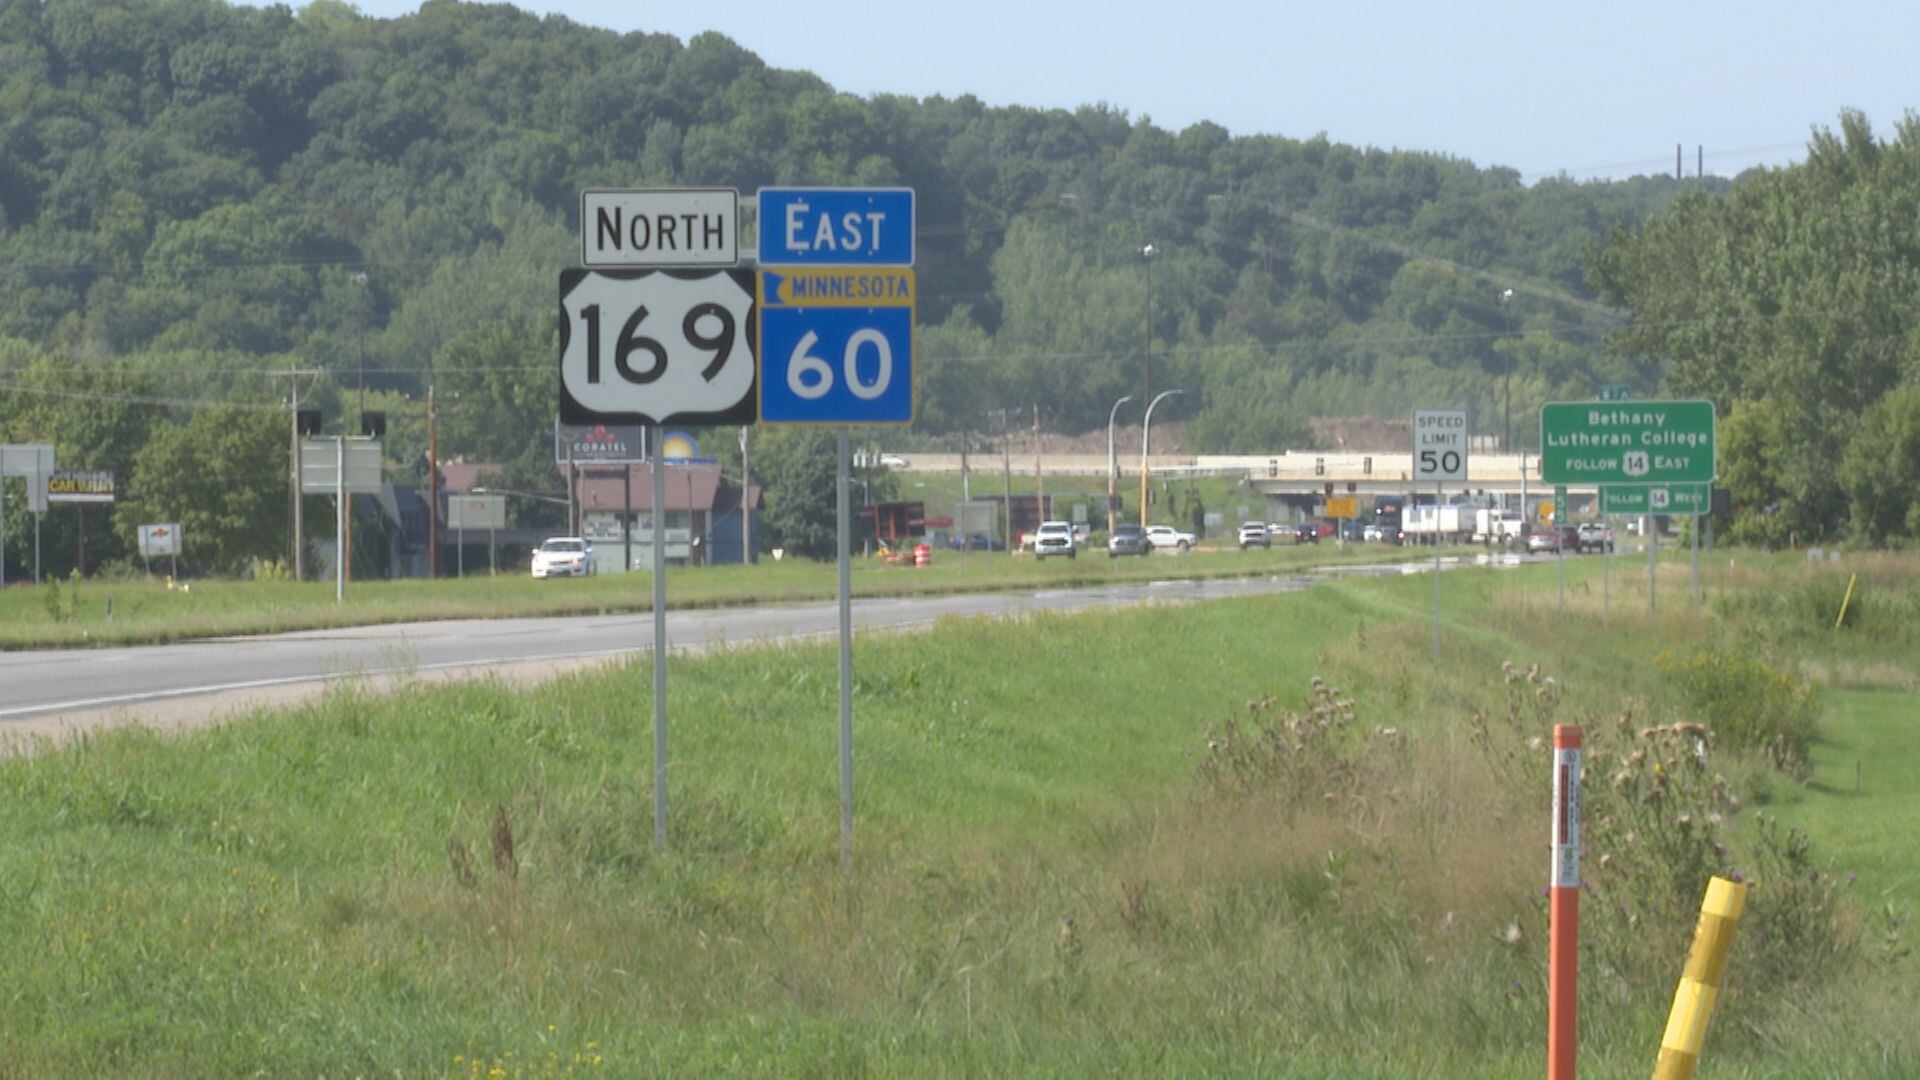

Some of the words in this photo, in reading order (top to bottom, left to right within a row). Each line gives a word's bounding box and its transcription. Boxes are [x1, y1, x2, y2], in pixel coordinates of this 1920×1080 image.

[596, 206, 724, 251] NORTH
[785, 203, 886, 252] EAST
[791, 274, 911, 299] MINNESOTA
[579, 302, 736, 386] 169
[786, 327, 894, 401] 60
[1418, 416, 1464, 429] SPEED
[1588, 411, 1667, 428] Bethany
[1422, 433, 1458, 445] LIMIT
[1547, 431, 1632, 448] Lutheran
[1640, 431, 1708, 448] College
[1420, 450, 1461, 474] 50
[1565, 458, 1618, 471] FOLLOW
[1626, 455, 1645, 472] 14
[1654, 456, 1691, 470] EAST
[1653, 492, 1666, 505] 14
